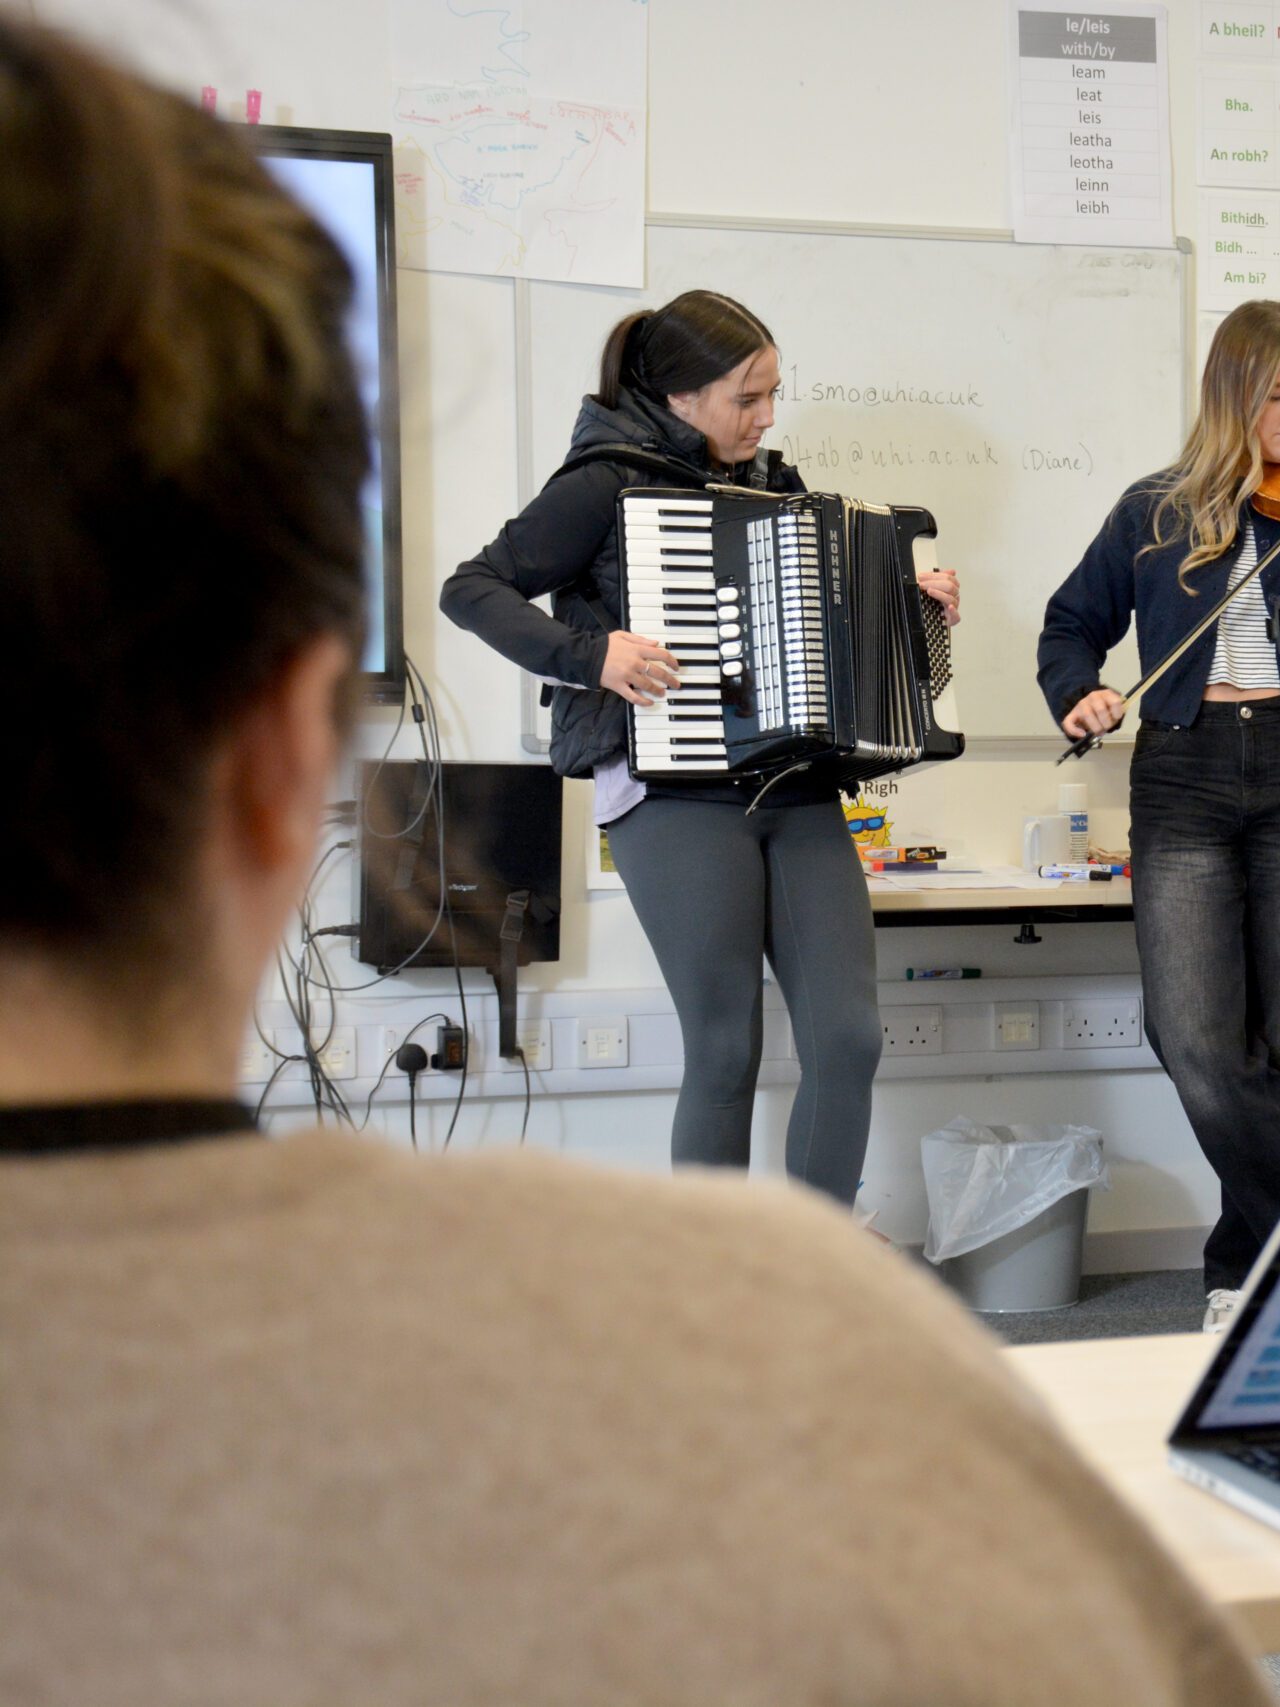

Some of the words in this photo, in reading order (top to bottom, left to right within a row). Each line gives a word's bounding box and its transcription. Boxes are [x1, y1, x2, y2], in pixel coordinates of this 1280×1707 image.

[1066, 19, 1110, 35] le/leis
[1209, 22, 1220, 35] A
[1223, 22, 1266, 38] bheil?
[1061, 41, 1116, 60] with/by
[1072, 64, 1106, 80] leam
[1076, 87, 1102, 102] leat
[1225, 98, 1254, 112] Bha.
[1078, 110, 1102, 125] leis
[1069, 132, 1112, 148] leatha
[1069, 155, 1114, 170] leotha
[1210, 148, 1228, 162] An
[1232, 150, 1268, 163] robh?
[1075, 177, 1110, 192] leinn
[1076, 199, 1110, 215] leibh
[1220, 211, 1269, 227] Bithidh.
[1214, 240, 1243, 254] Bidh
[1224, 272, 1246, 284] Am
[1248, 272, 1266, 285] bi?
[1021, 442, 1095, 477] (Diane)
[830, 530, 842, 605] HOHNER
[864, 780, 898, 798] Righ
